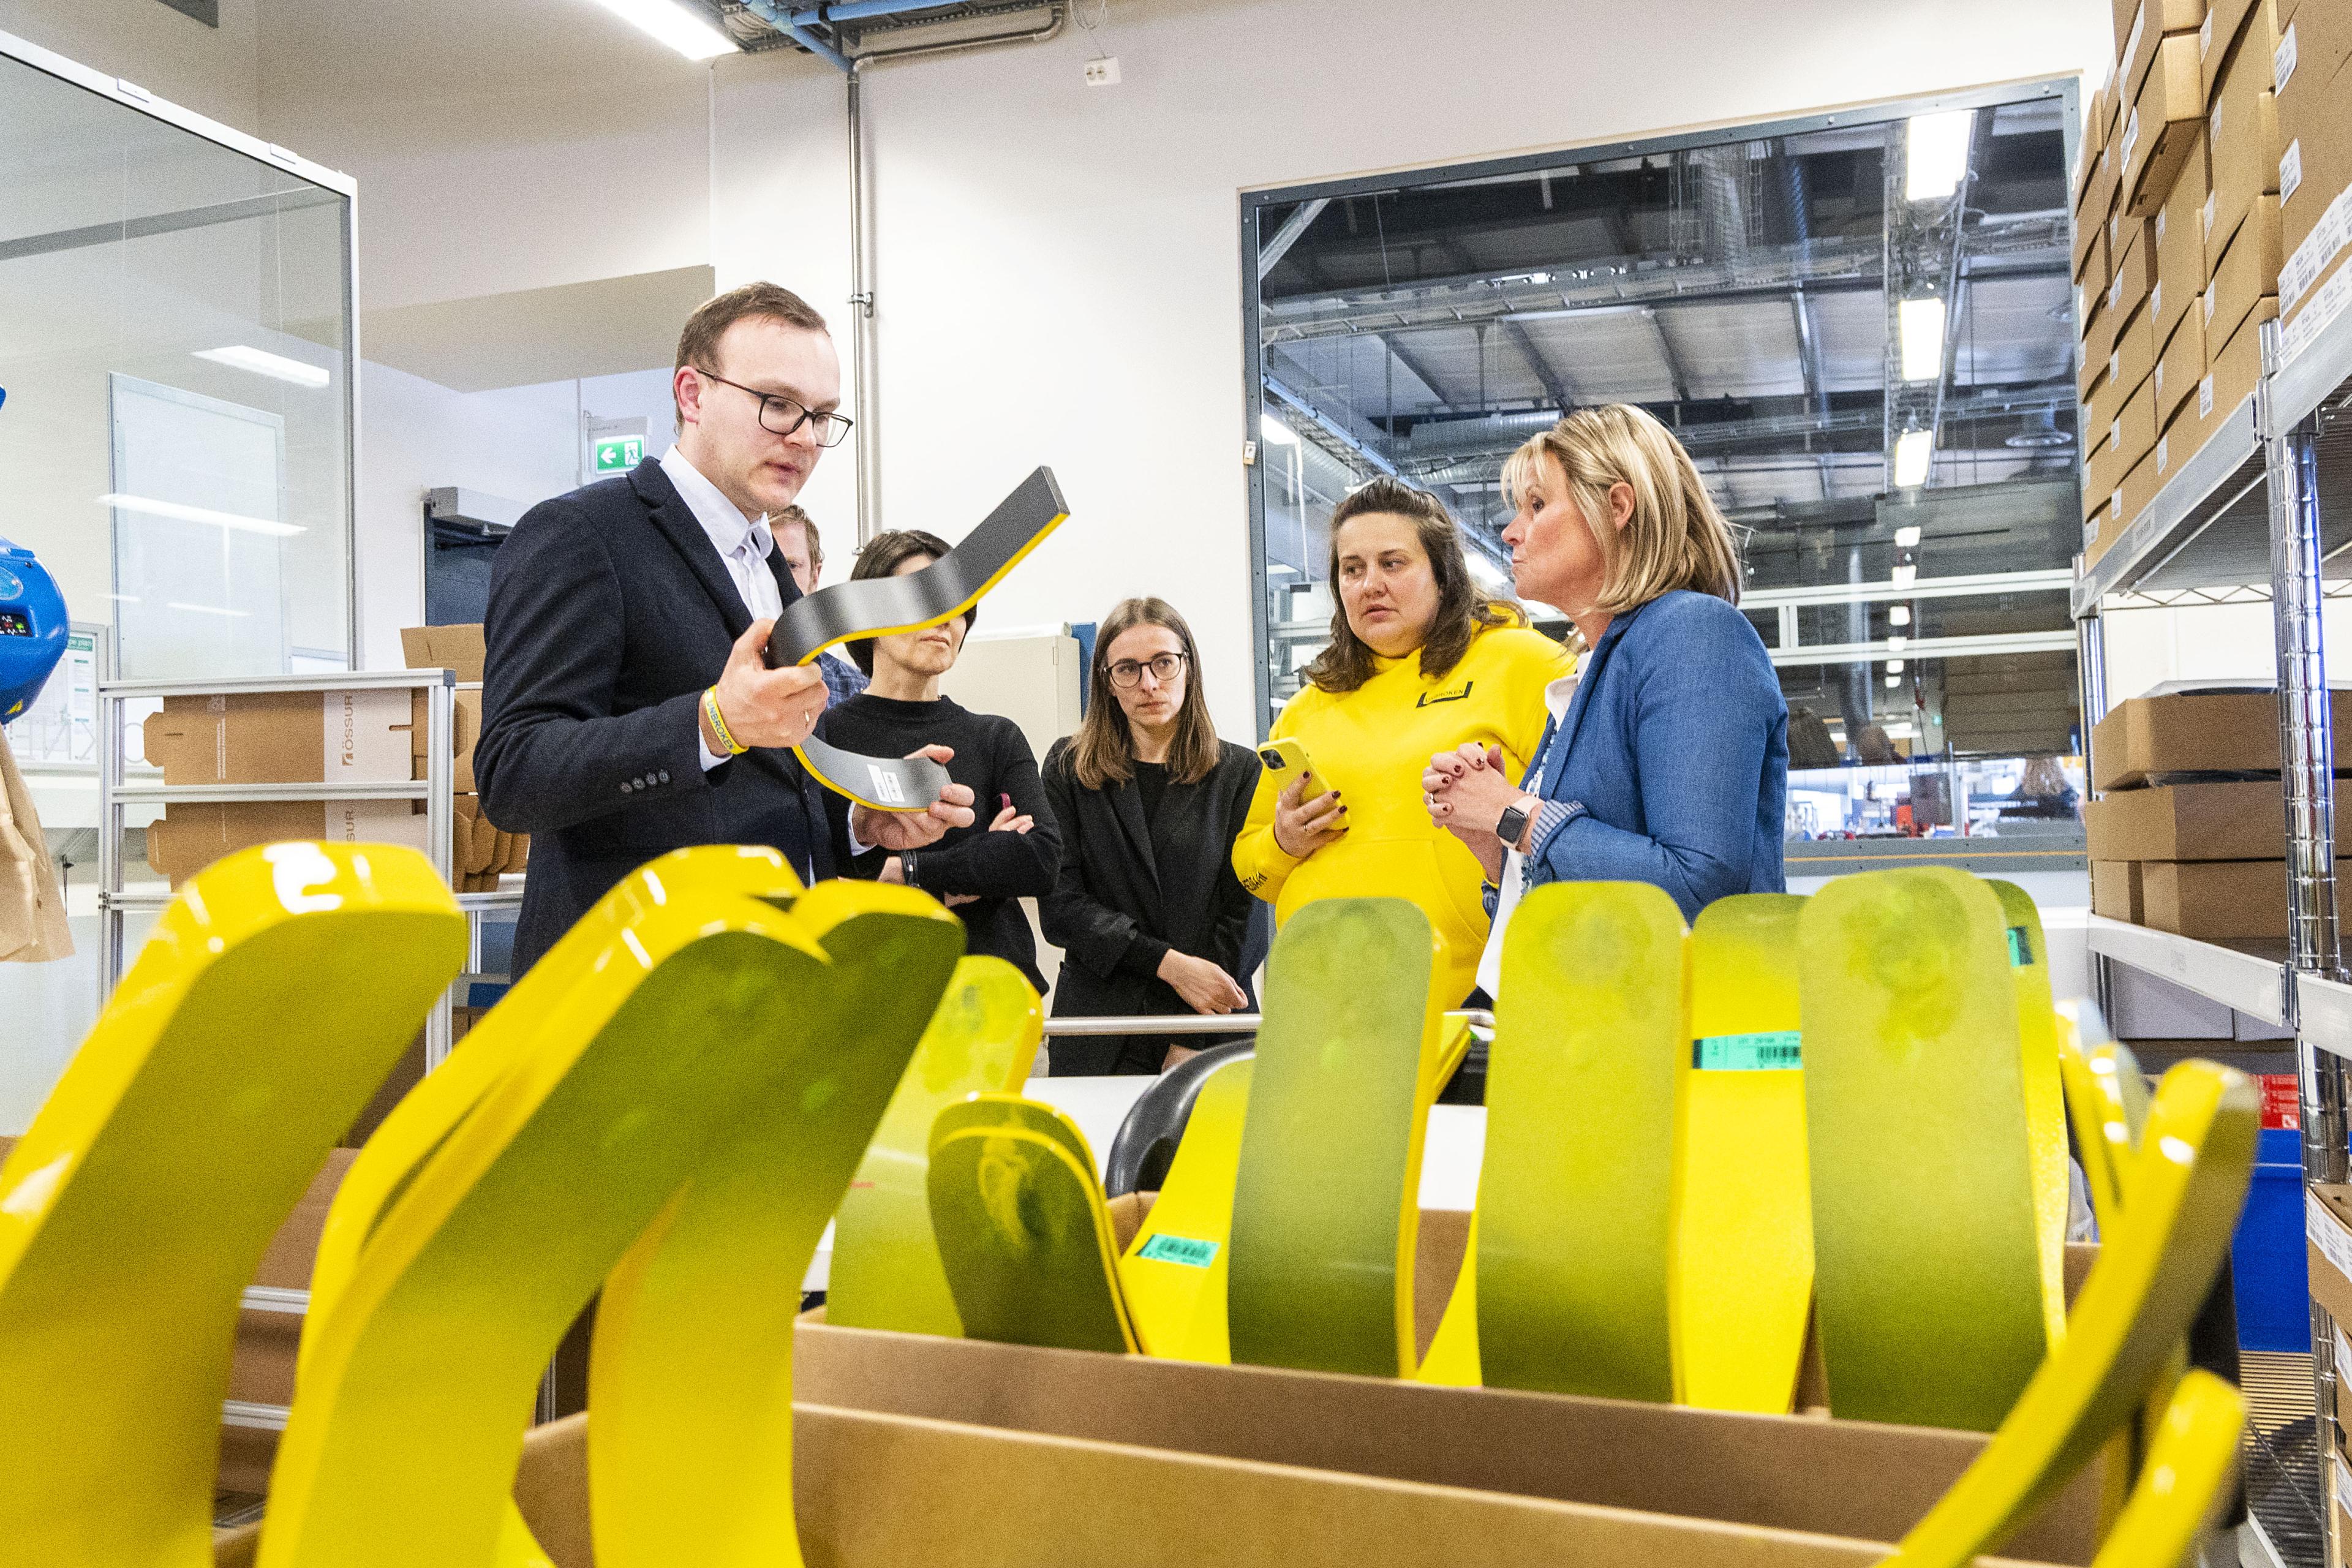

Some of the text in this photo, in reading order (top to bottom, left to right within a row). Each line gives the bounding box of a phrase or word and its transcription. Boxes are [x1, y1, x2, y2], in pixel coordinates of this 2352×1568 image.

[341, 695, 354, 751] ÖSSUR
[706, 700, 734, 749] UNBROKEN
[345, 810, 355, 842] SUR
